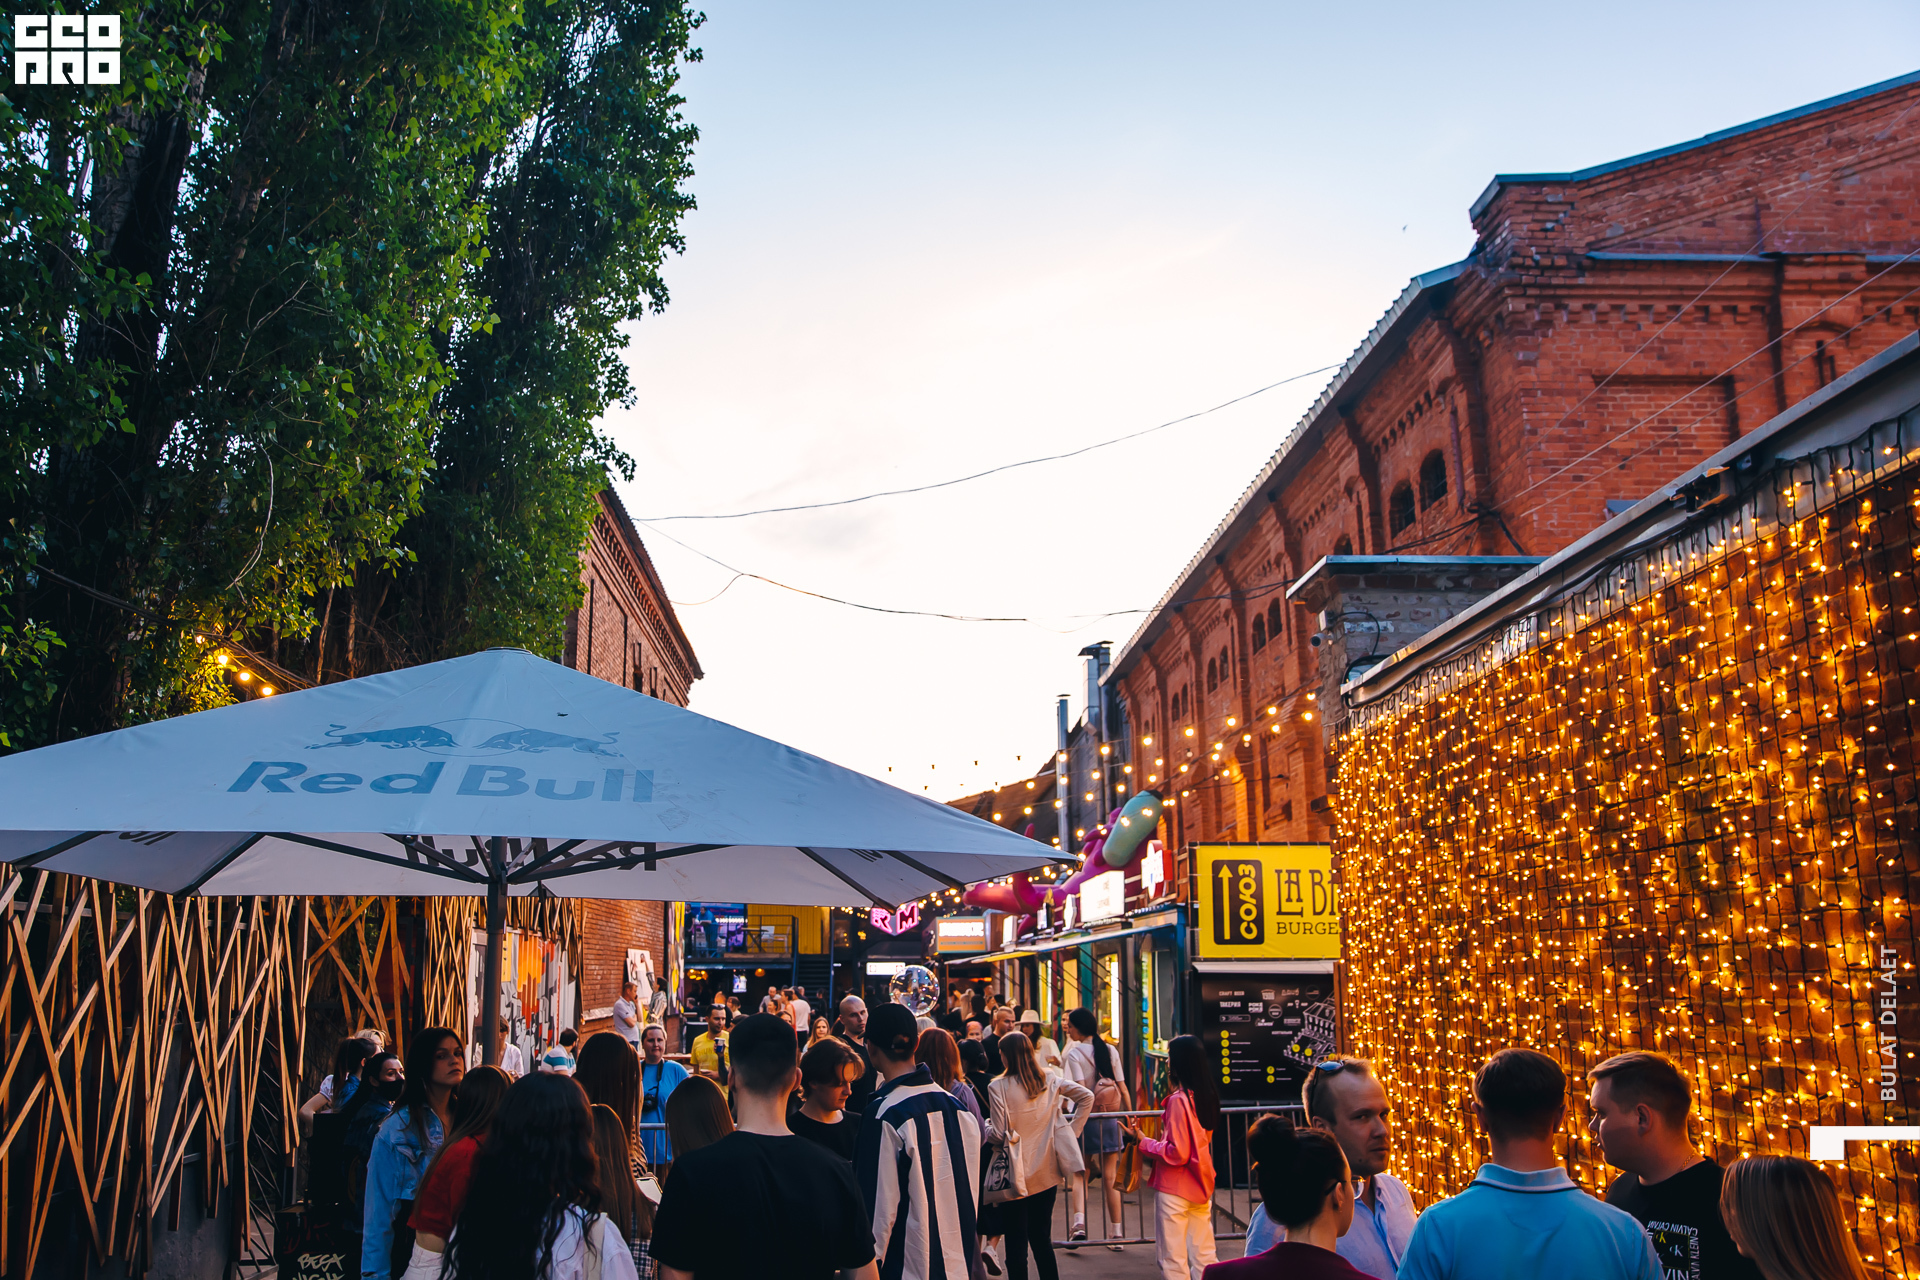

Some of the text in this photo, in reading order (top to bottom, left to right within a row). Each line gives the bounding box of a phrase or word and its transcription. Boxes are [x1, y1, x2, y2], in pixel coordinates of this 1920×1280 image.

[226, 760, 655, 803] Red Bull
[1274, 869, 1304, 918] LA
[1276, 921, 1339, 935] BURGE
[1689, 1236, 1701, 1280] ALVIN KLEIN
